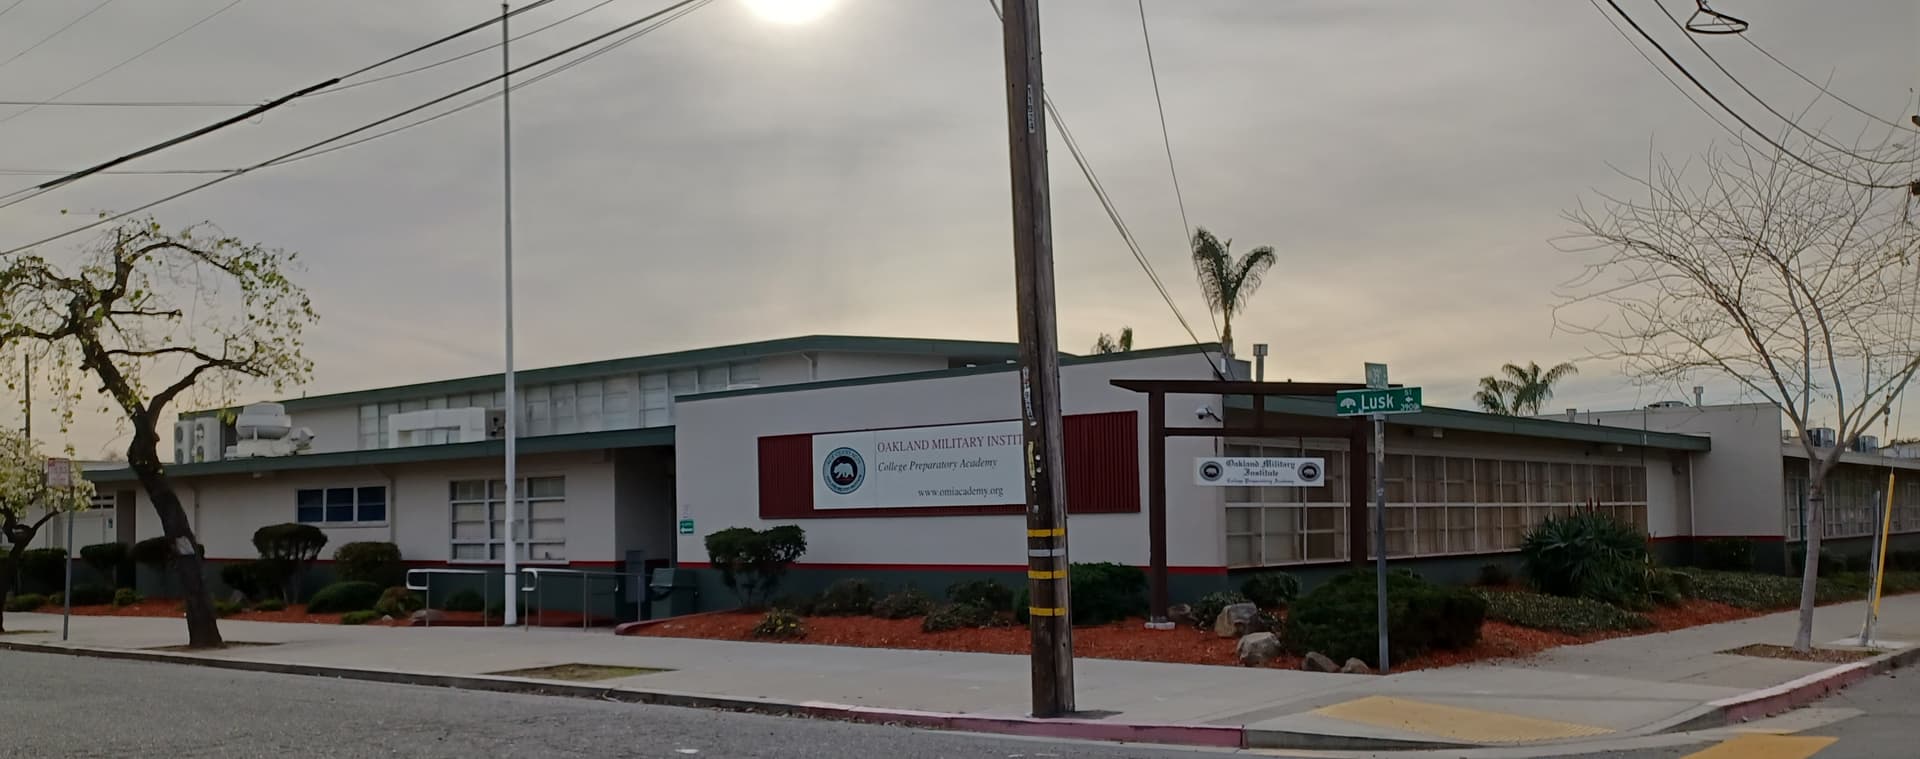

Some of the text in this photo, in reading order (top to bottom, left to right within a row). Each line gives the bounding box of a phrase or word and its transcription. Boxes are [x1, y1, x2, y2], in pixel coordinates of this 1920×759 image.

[1361, 393, 1394, 409] Lusk
[877, 433, 1023, 453] OAKLAND MILITARY INSTIT
[878, 456, 998, 473] College Preparatory Academy
[1226, 459, 1295, 469] Oakland Military
[1244, 468, 1278, 477] Institute
[918, 486, 1004, 498] www.omiacademy.org
